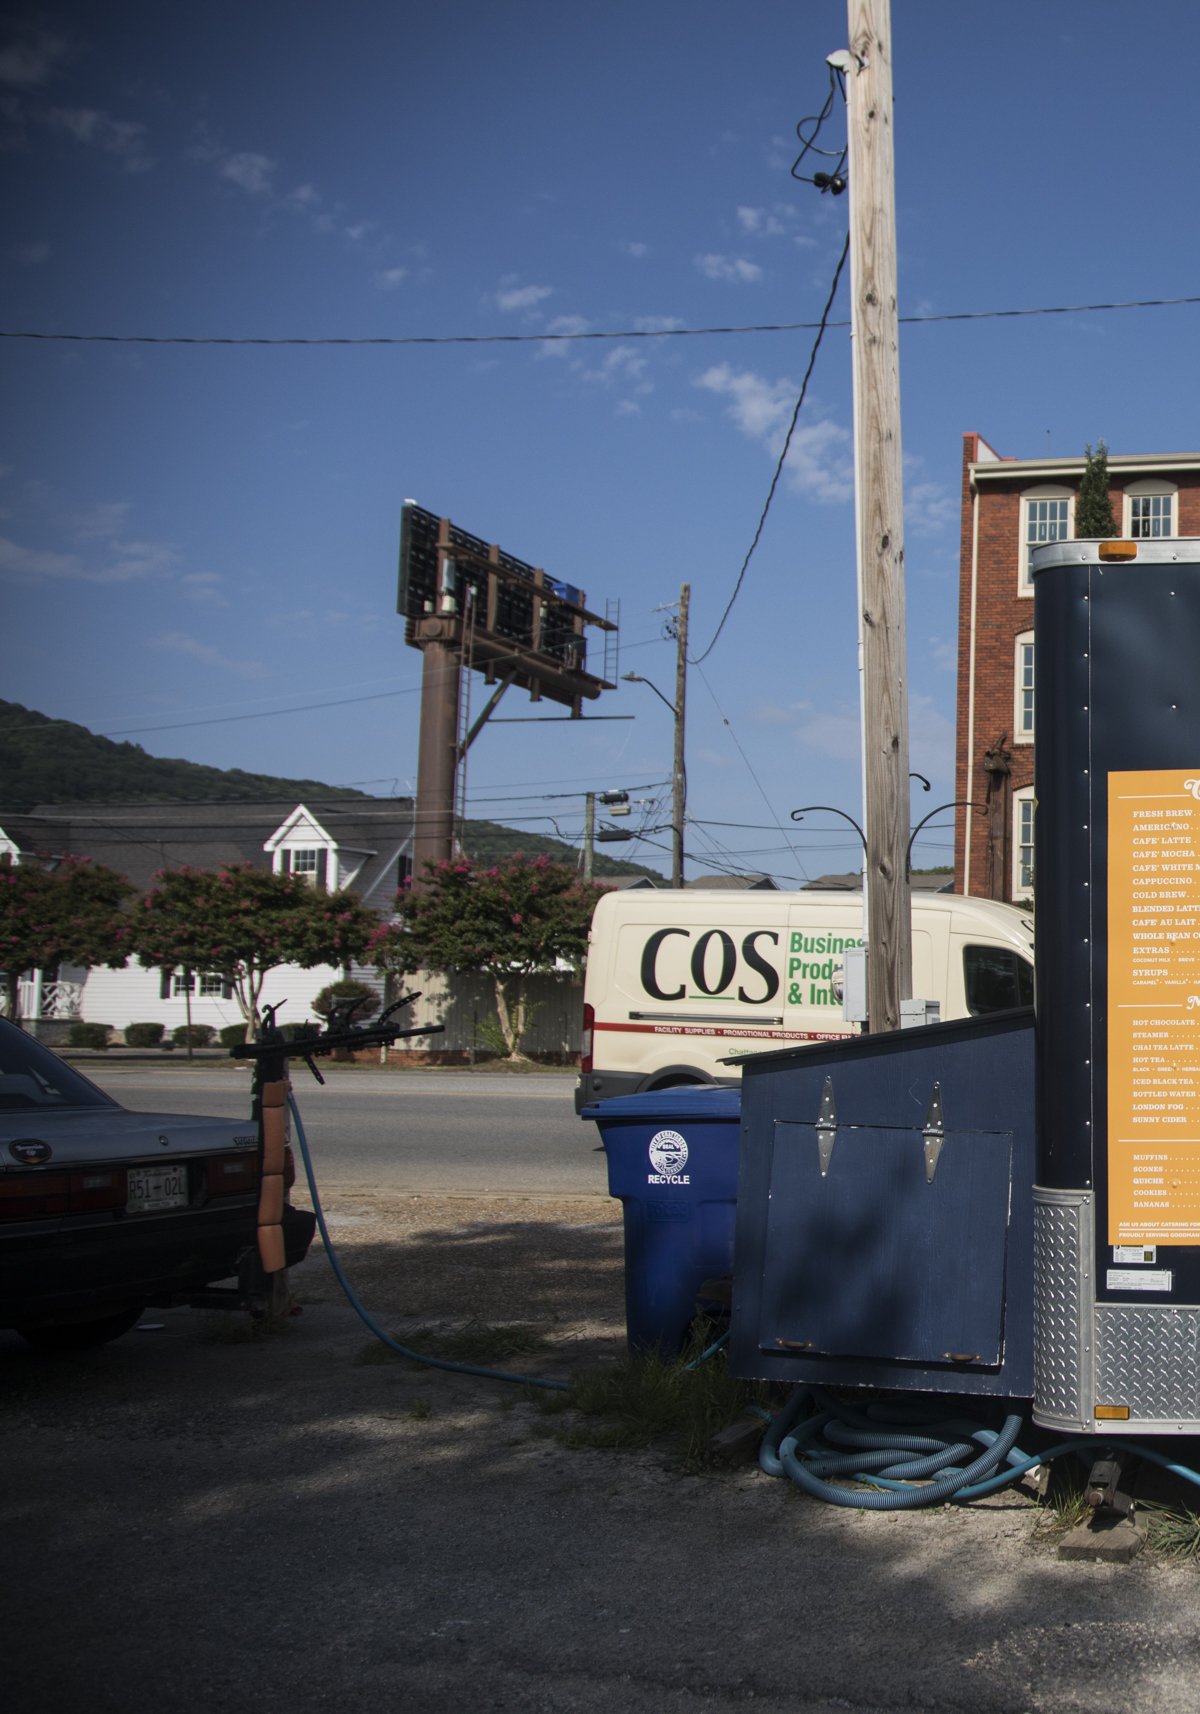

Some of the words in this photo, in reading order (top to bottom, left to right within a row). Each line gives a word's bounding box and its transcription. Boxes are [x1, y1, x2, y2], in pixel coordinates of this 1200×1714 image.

[1133, 810, 1163, 818] FRESH
[1166, 810, 1192, 818] BREW
[1133, 823, 1189, 831] AMERICANO
[1162, 850, 1195, 858] MOCHA
[1132, 891, 1157, 899] COLD
[1159, 891, 1186, 899] BREW
[1133, 932, 1164, 940] WHOLE
[1166, 932, 1190, 940] BEAN
[640, 928, 780, 1004] COS
[788, 958, 844, 980] Prod
[788, 983, 802, 1004] &
[654, 1026, 682, 1034] FACILITY
[684, 1028, 716, 1036] SUPPLIES
[724, 1029, 770, 1038] PROMOTIONAL
[772, 1031, 808, 1040] PRODUCTS
[648, 1174, 690, 1184] RECYCLE
